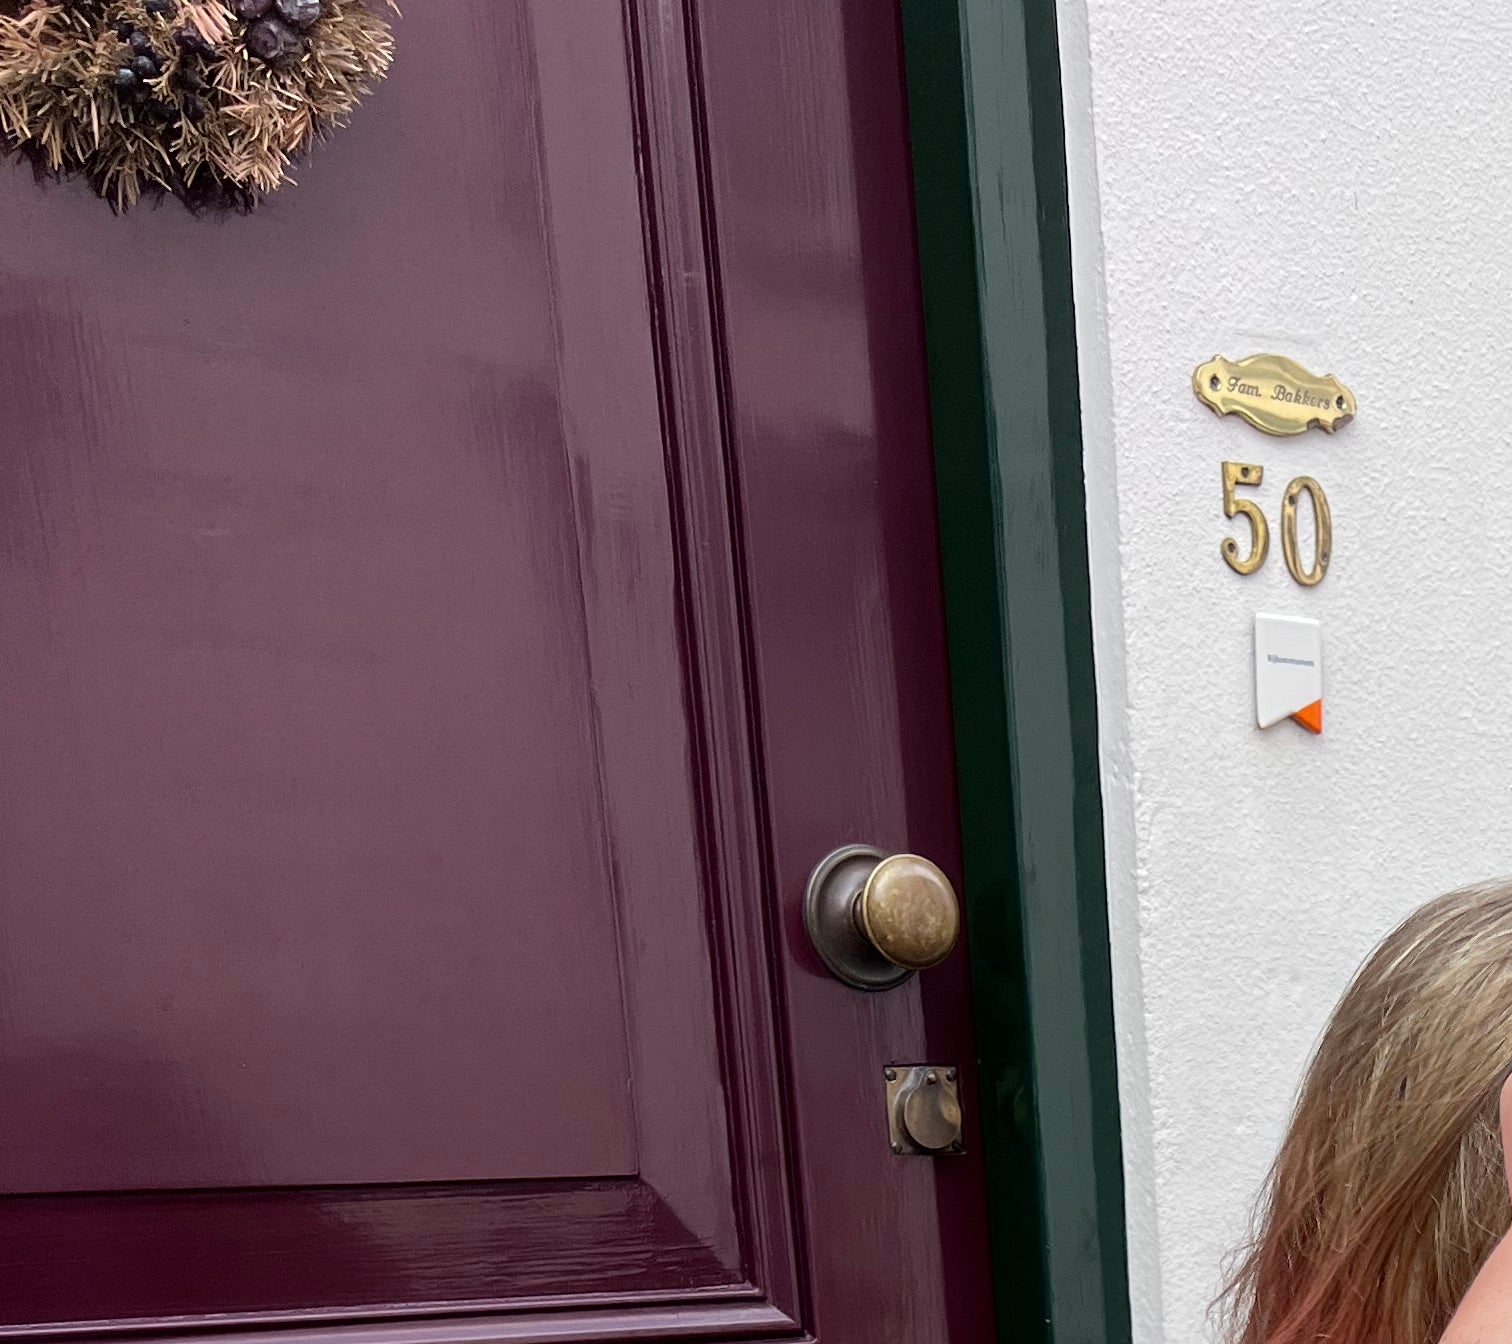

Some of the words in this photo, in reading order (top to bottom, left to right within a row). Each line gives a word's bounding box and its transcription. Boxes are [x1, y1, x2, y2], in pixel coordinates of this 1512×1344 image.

[1226, 375, 1262, 398] Fam.
[1270, 383, 1331, 411] Bakkers
[1221, 460, 1332, 587] 50
